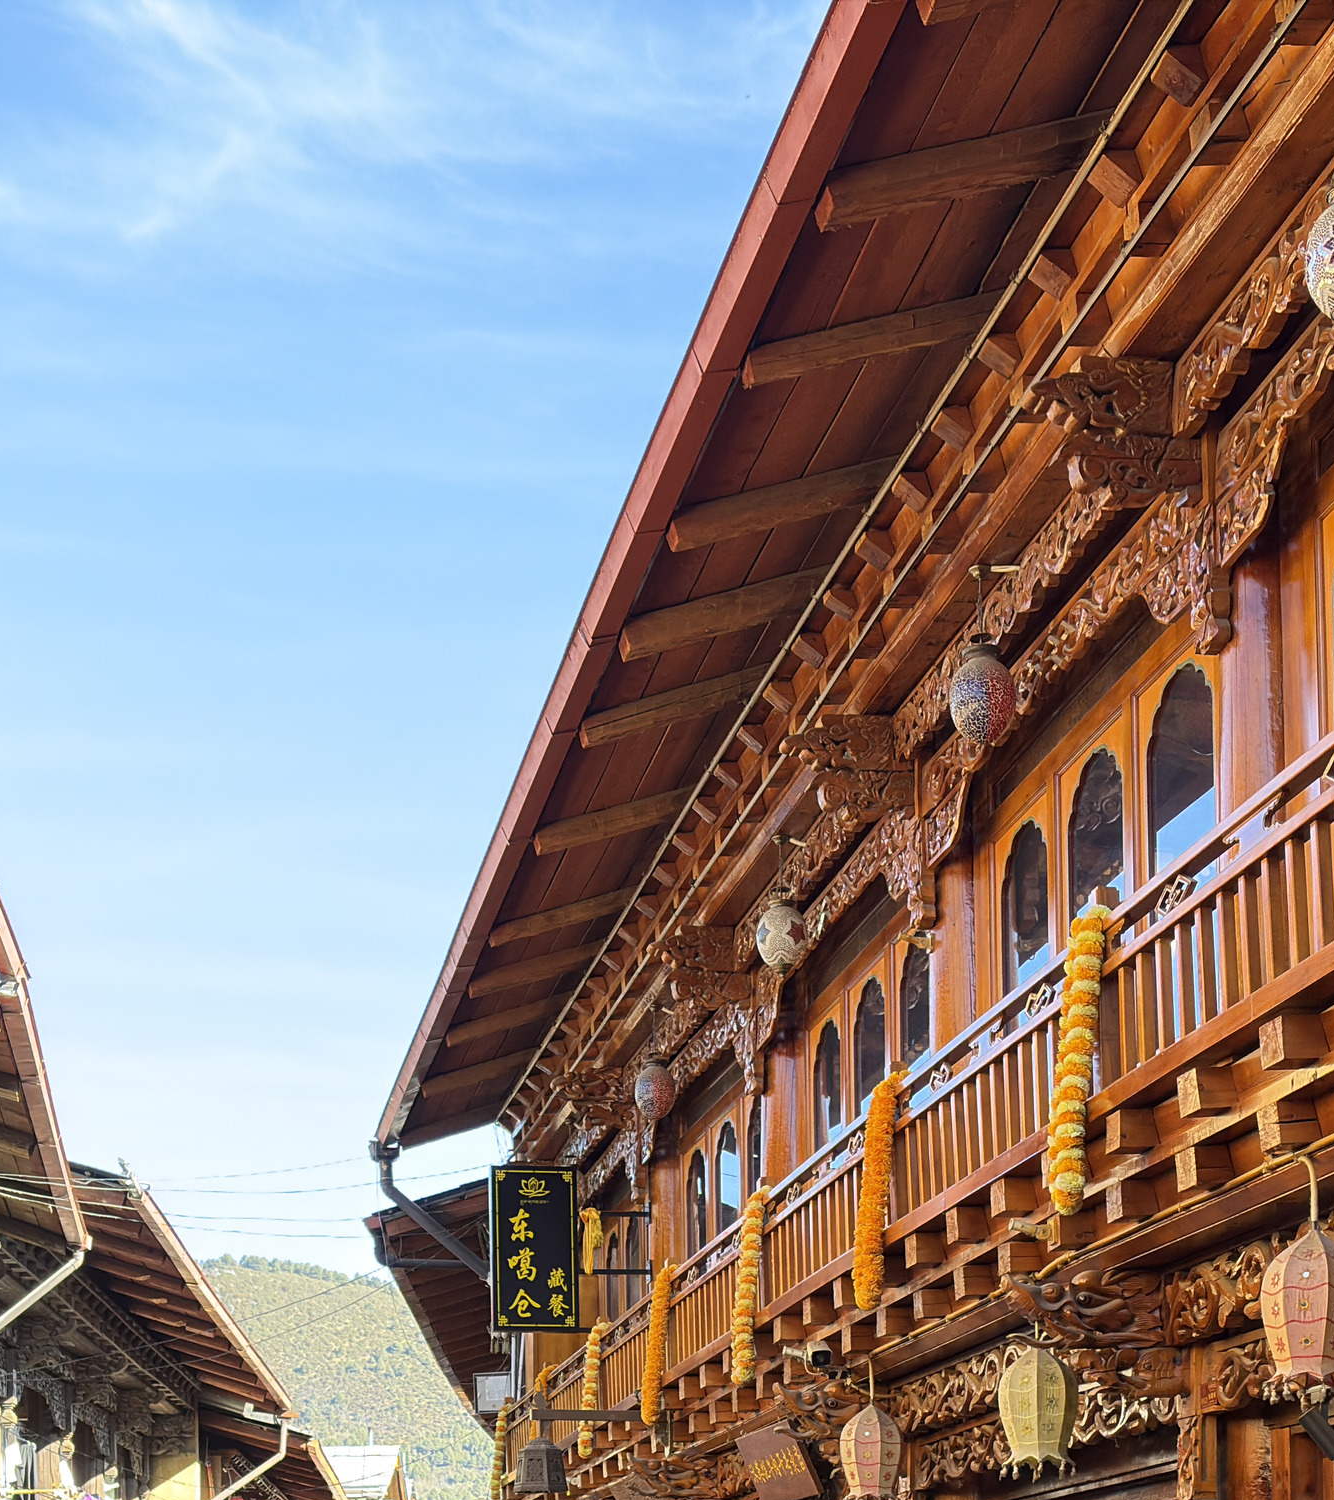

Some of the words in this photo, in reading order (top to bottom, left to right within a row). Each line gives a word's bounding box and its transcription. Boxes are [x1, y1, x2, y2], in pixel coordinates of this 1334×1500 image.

[507, 1208, 542, 1318] 东噶仓
[547, 1267, 570, 1318] 藏餐
